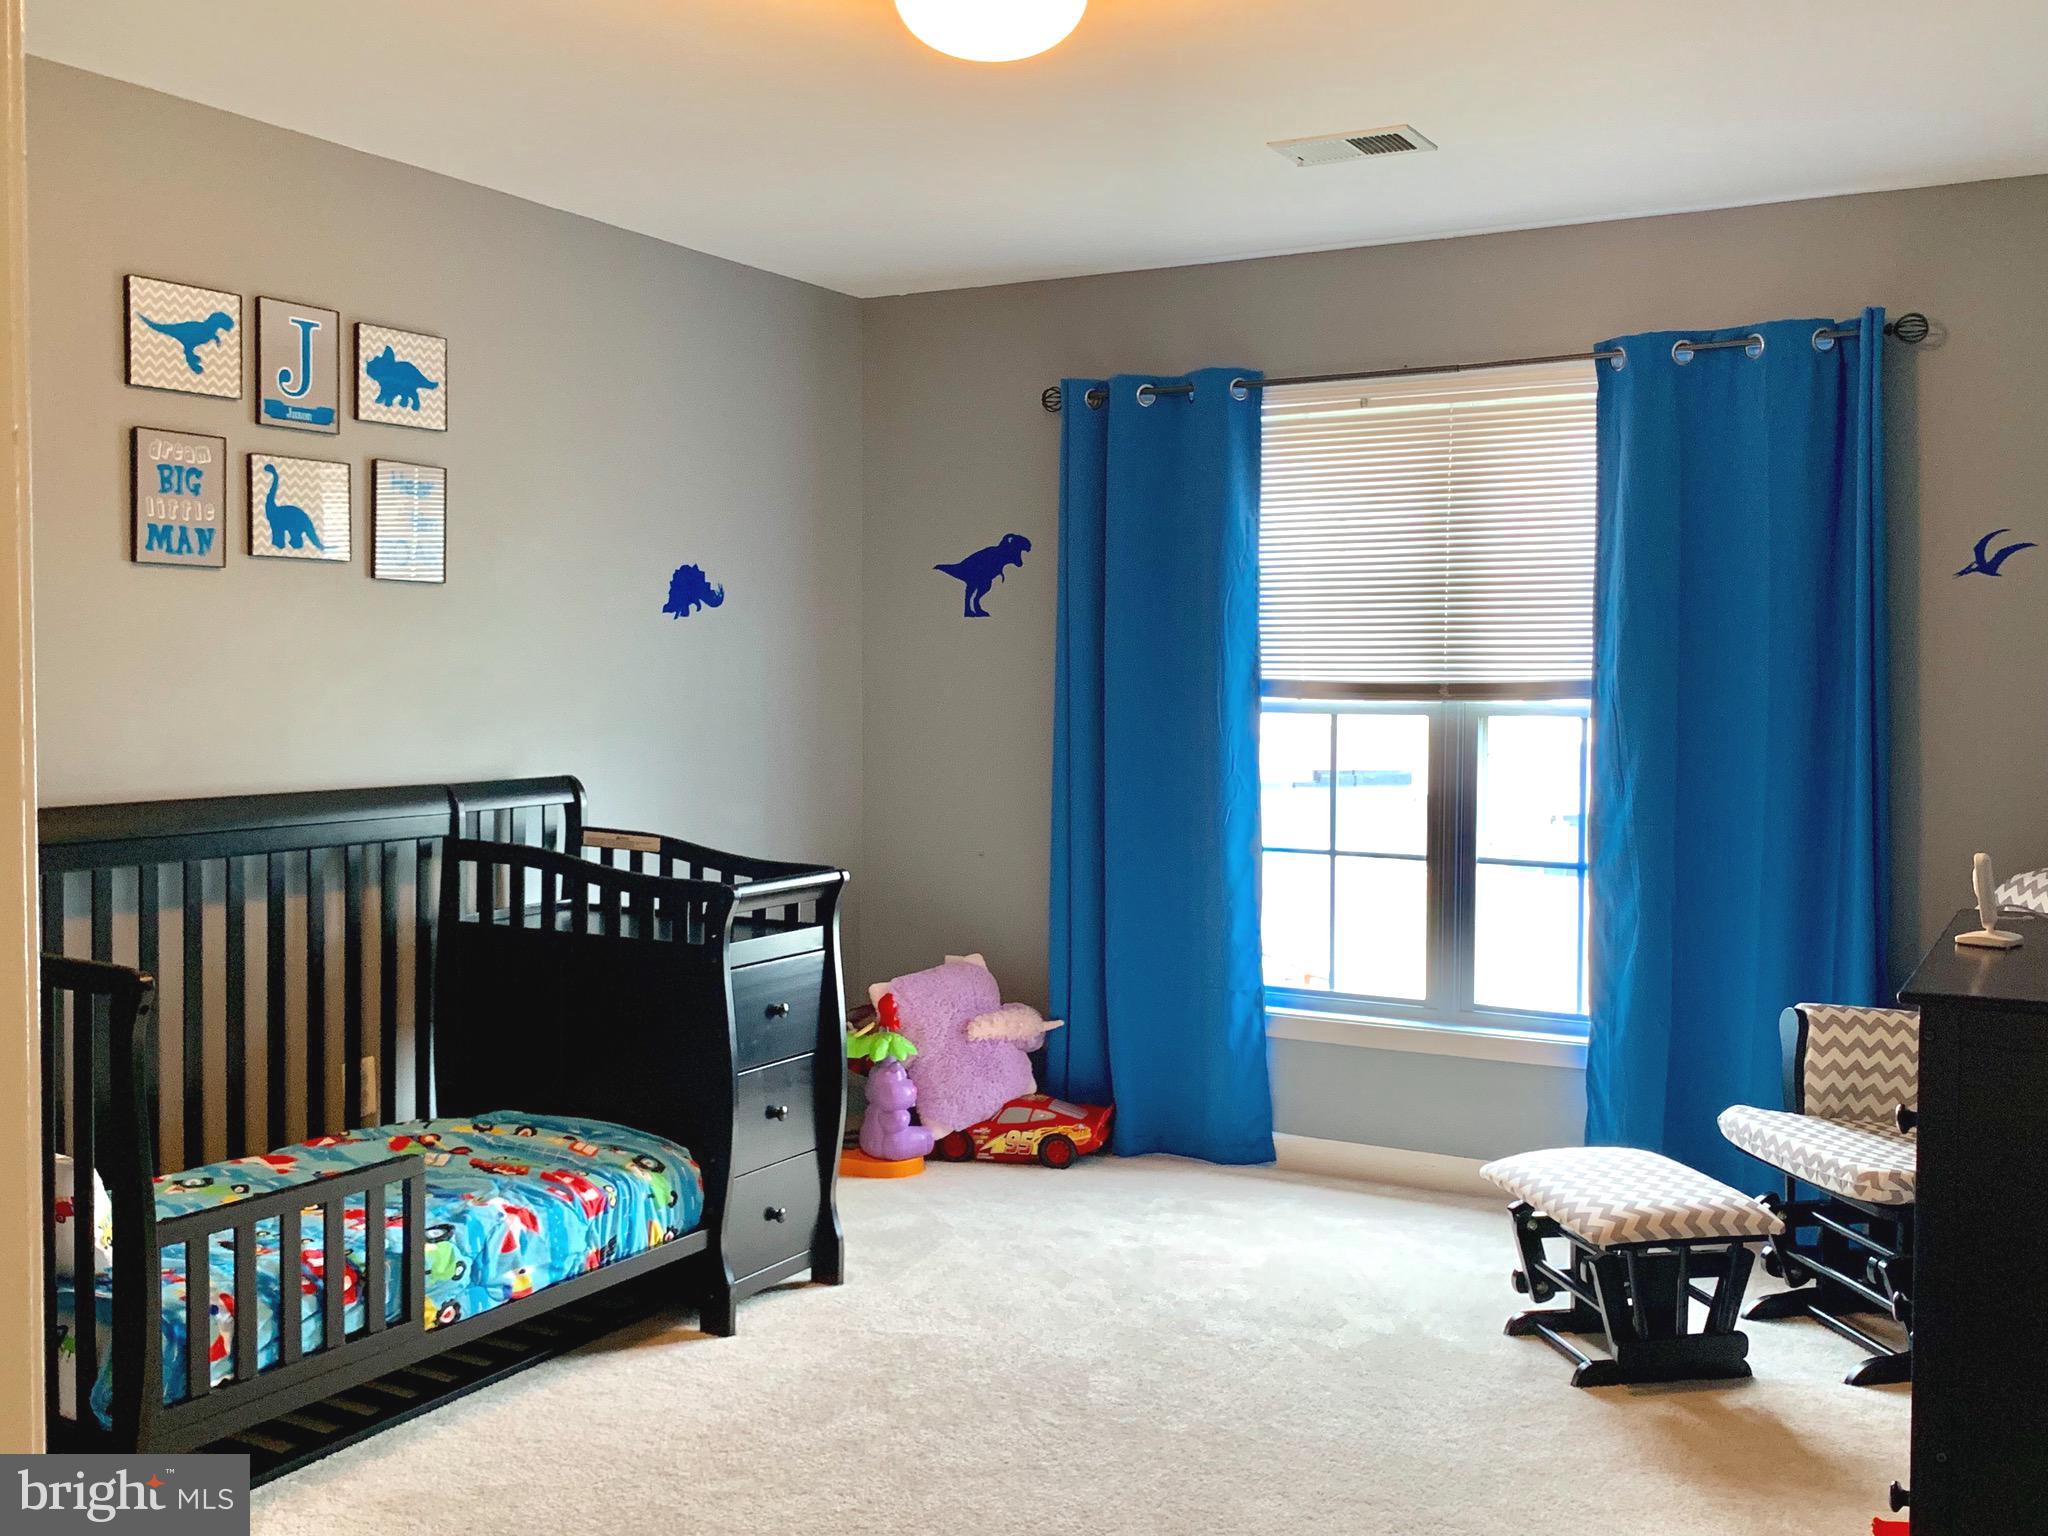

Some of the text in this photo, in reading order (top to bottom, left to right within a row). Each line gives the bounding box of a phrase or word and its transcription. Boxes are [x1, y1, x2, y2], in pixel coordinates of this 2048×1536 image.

[277, 316, 321, 398] J
[156, 463, 203, 496] BIG
[145, 522, 216, 557] MAN
[1004, 1129, 1033, 1156] 95
